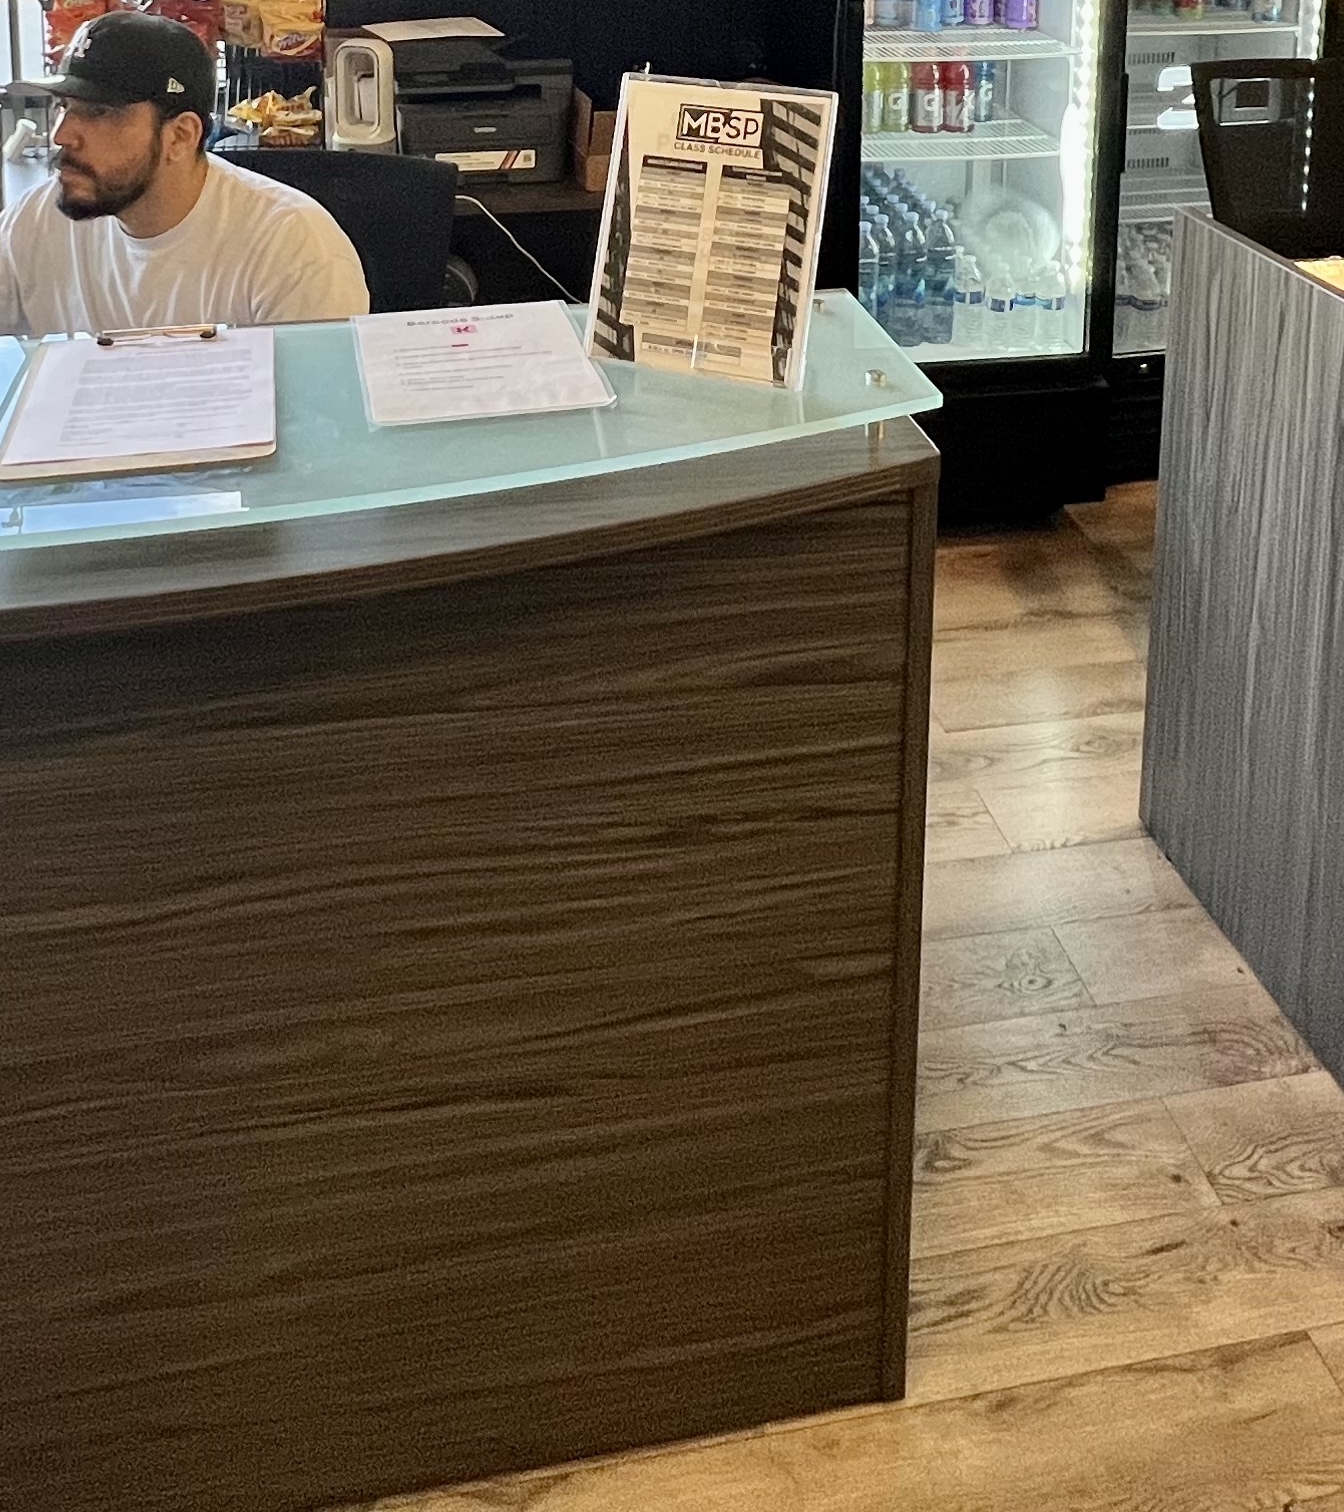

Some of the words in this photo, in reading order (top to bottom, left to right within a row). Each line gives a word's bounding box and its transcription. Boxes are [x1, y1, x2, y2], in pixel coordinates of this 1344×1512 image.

[681, 110, 760, 141] MBSP
[674, 142, 705, 153] CLASS
[708, 144, 762, 160] SCHEDULE
